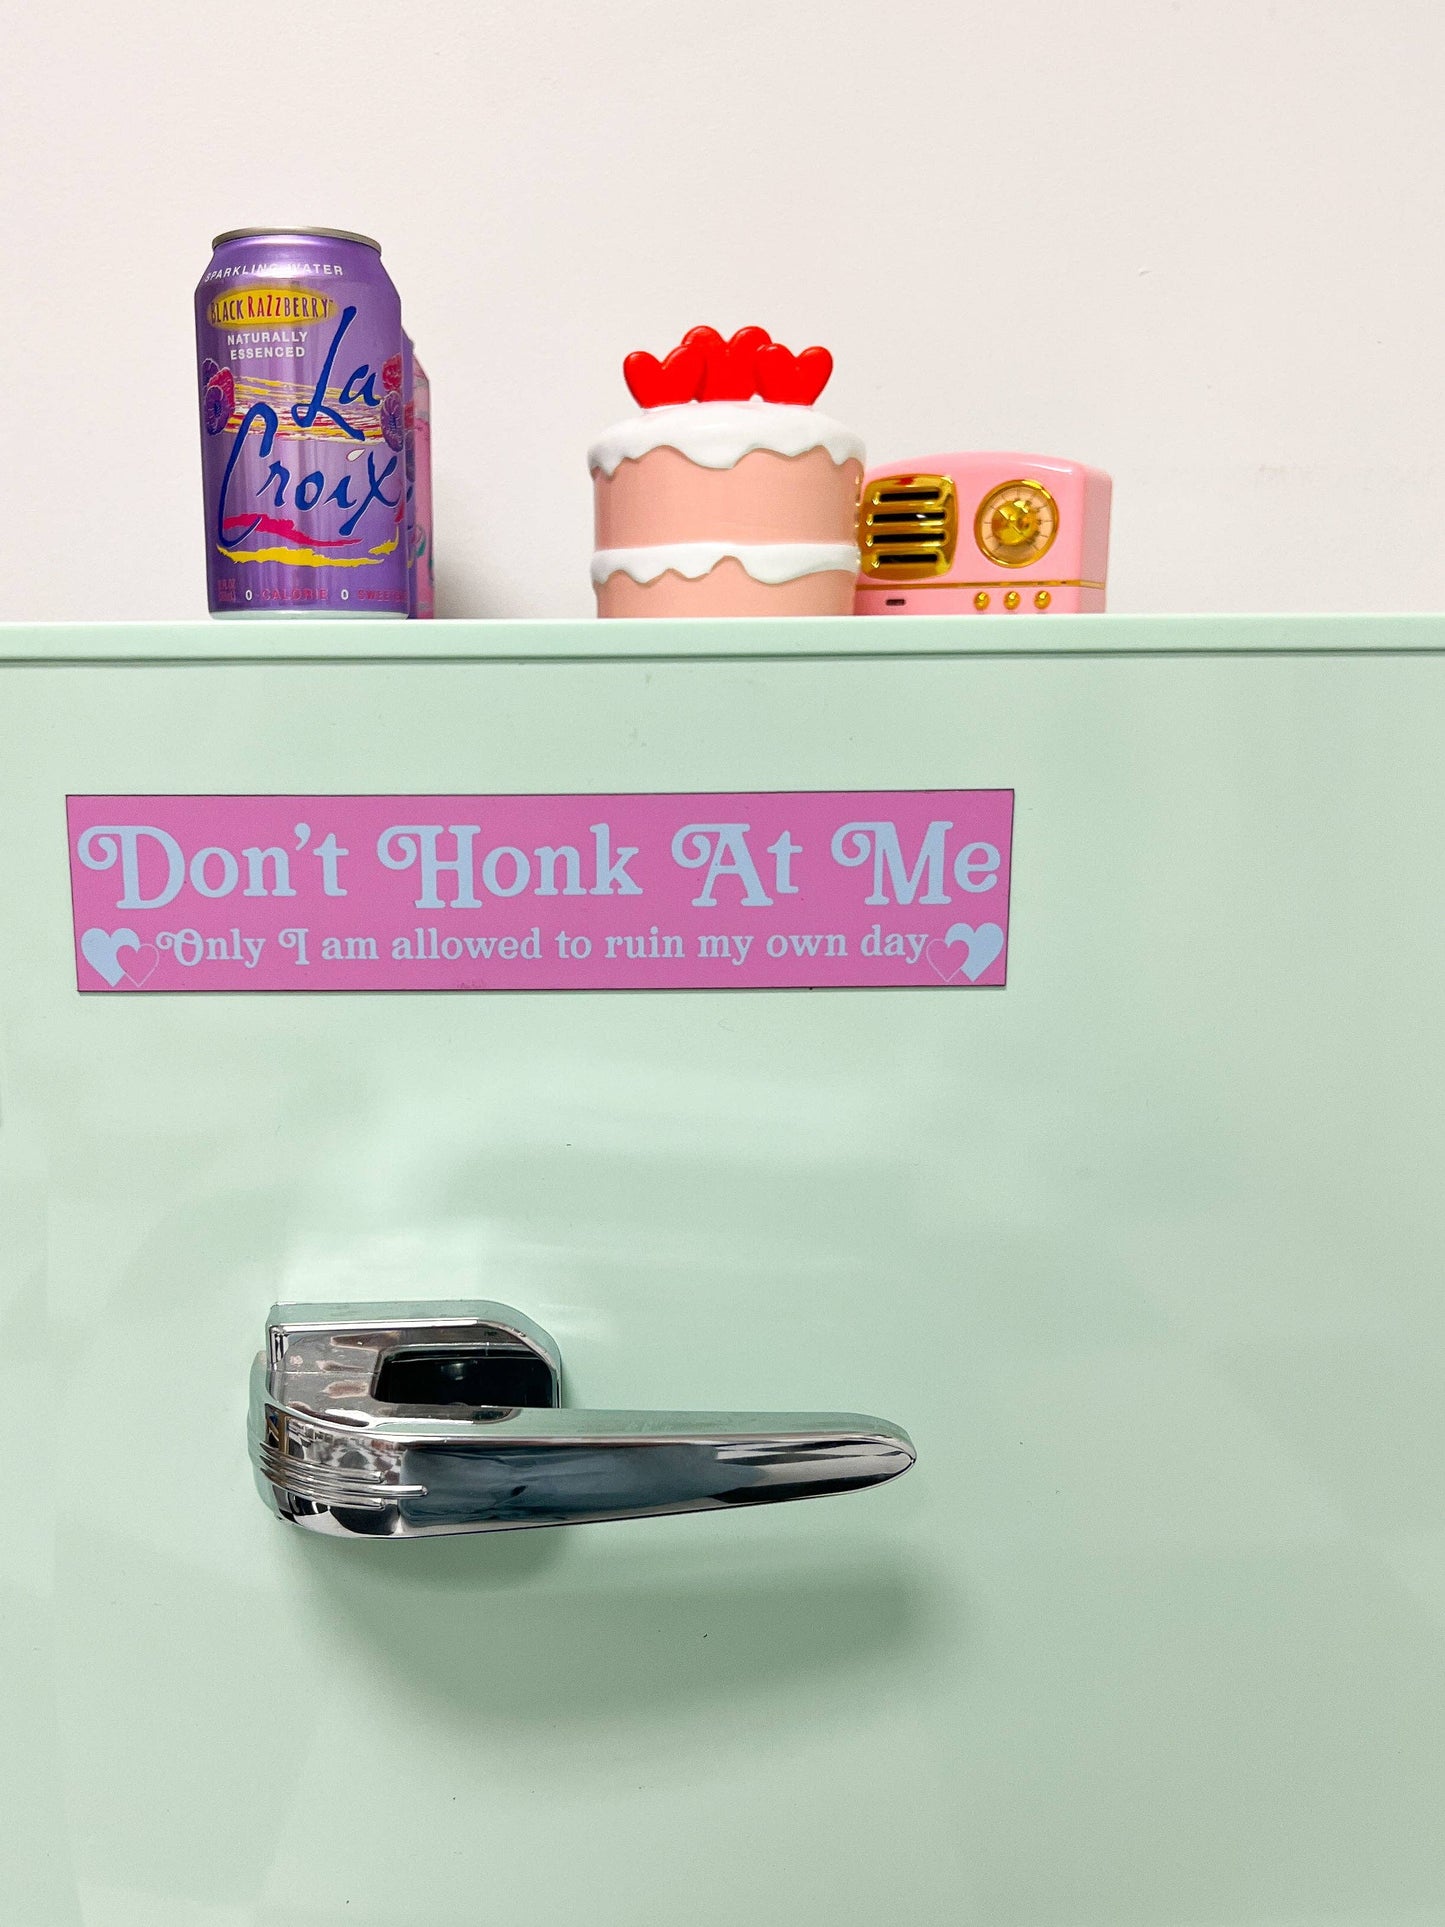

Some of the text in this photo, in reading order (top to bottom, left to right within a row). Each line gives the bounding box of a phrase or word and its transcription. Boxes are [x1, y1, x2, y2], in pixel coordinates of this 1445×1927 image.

[204, 263, 344, 283] SPARKLING WATER
[210, 294, 329, 324] BLACK RAZZBERRY
[227, 331, 308, 346] NATURALLY
[230, 346, 305, 360] ESSENCED
[291, 305, 382, 441] La
[218, 403, 401, 547] Croix
[245, 589, 253, 600] 0
[261, 588, 328, 600] CALORIE
[340, 589, 349, 600] 0
[77, 821, 1001, 909] Don't Honk At Me
[155, 924, 929, 968] Only I am allowed to ruin my own day
